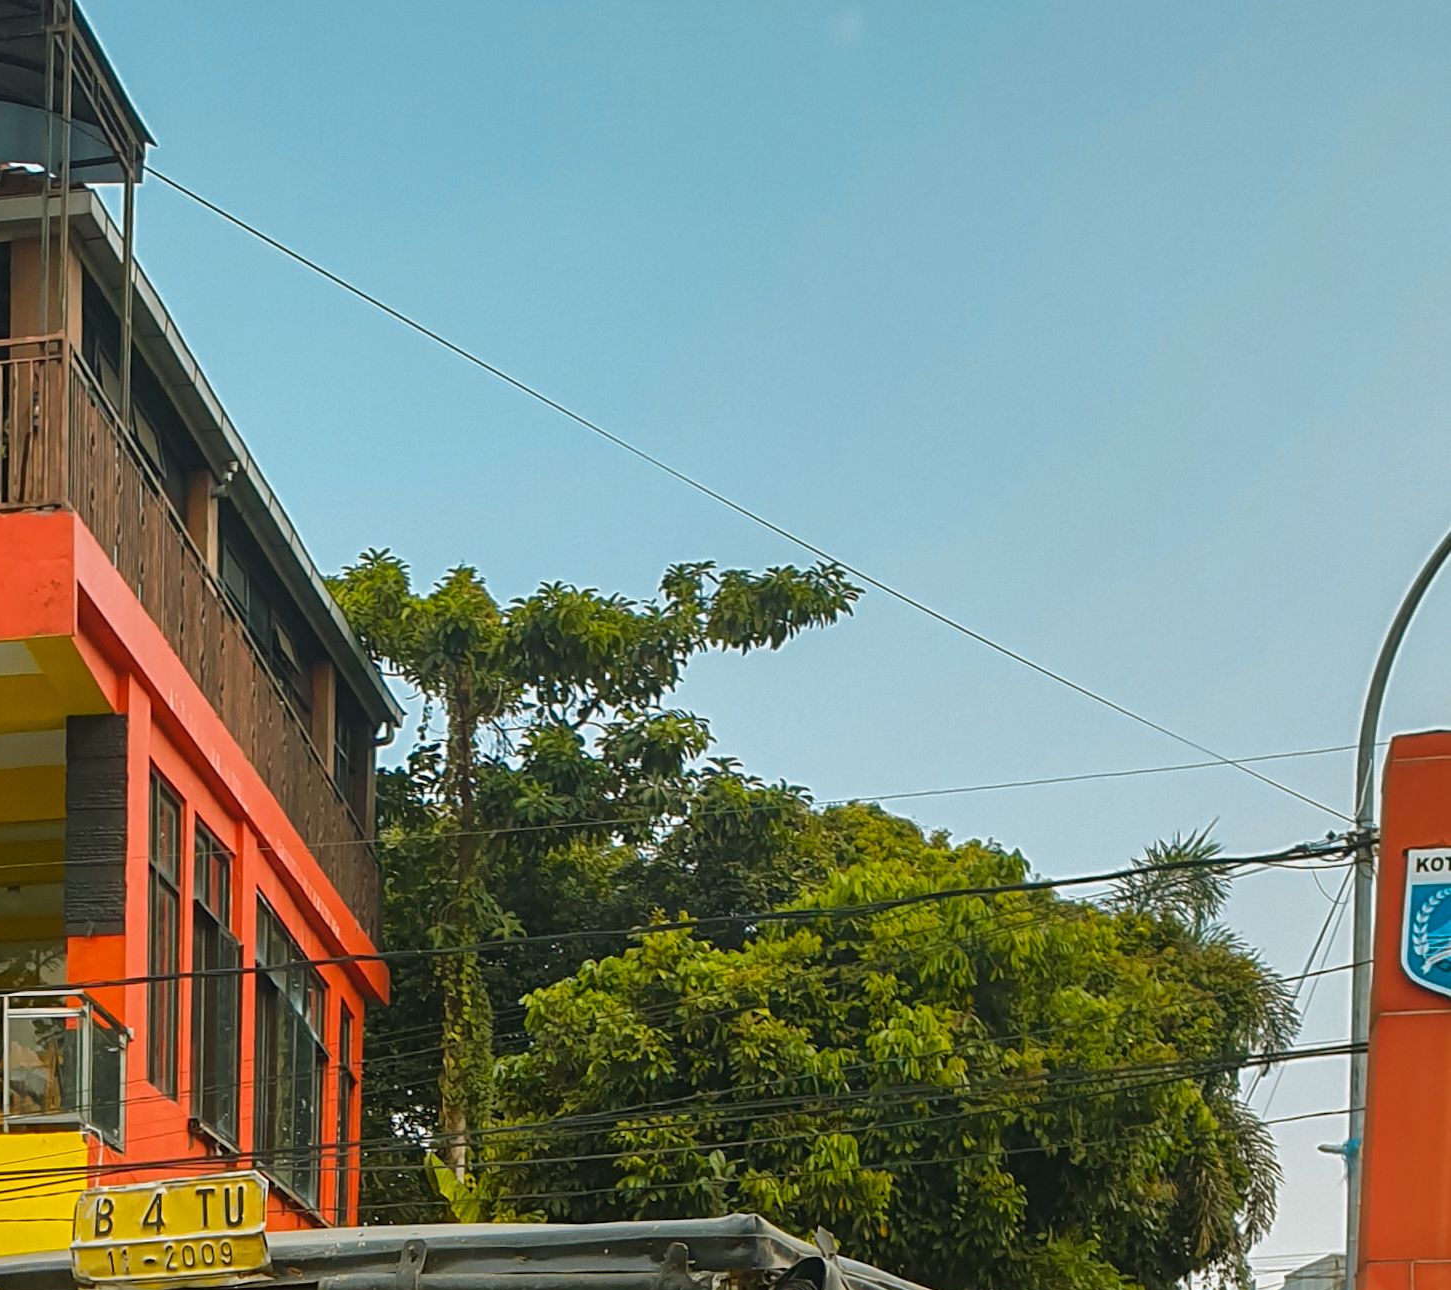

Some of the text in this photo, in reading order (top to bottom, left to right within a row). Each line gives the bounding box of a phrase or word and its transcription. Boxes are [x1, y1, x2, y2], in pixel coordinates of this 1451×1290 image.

[94, 1186, 245, 1237] B 4 TU
